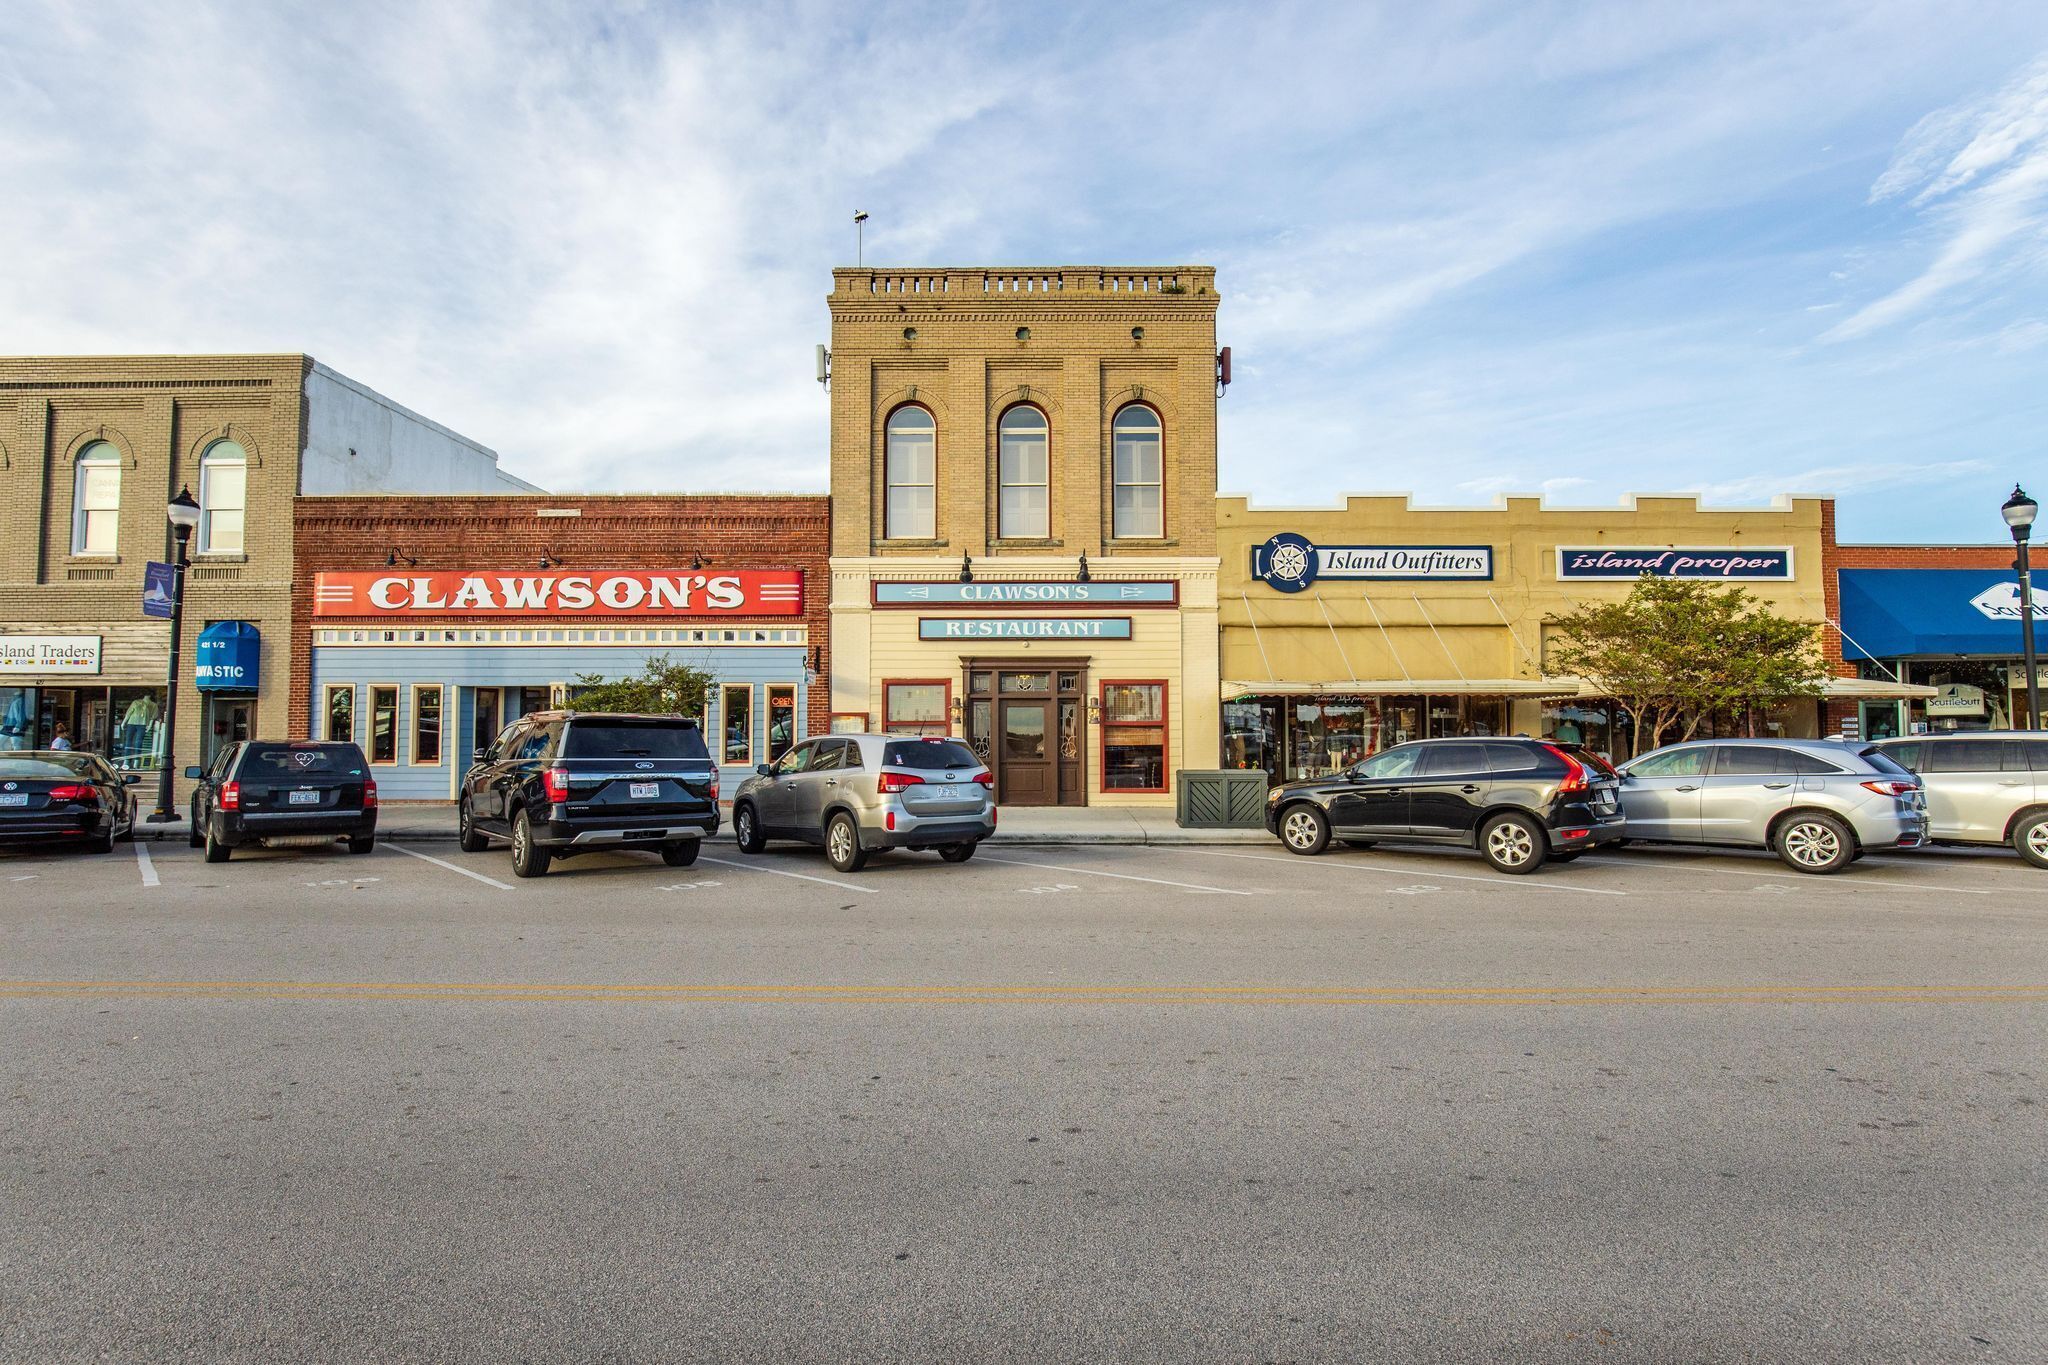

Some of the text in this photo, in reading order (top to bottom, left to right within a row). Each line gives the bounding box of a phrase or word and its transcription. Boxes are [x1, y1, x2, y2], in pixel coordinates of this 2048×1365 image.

[1271, 537, 1279, 545] N
[1306, 544, 1313, 552] E
[1327, 551, 1483, 574] Island Outfitters
[1571, 552, 1779, 576] island proper
[1263, 571, 1271, 579] W
[367, 576, 745, 609] CLAWSON'S
[960, 585, 1089, 600] CLAWSON'S
[1981, 602, 2048, 616] Scutl
[946, 621, 1104, 636] RESTAURANT
[40, 645, 95, 657] Traders
[2015, 667, 2048, 679] Sctle
[772, 697, 793, 705] OPEN
[1929, 698, 1979, 706] Scuttlebutt
